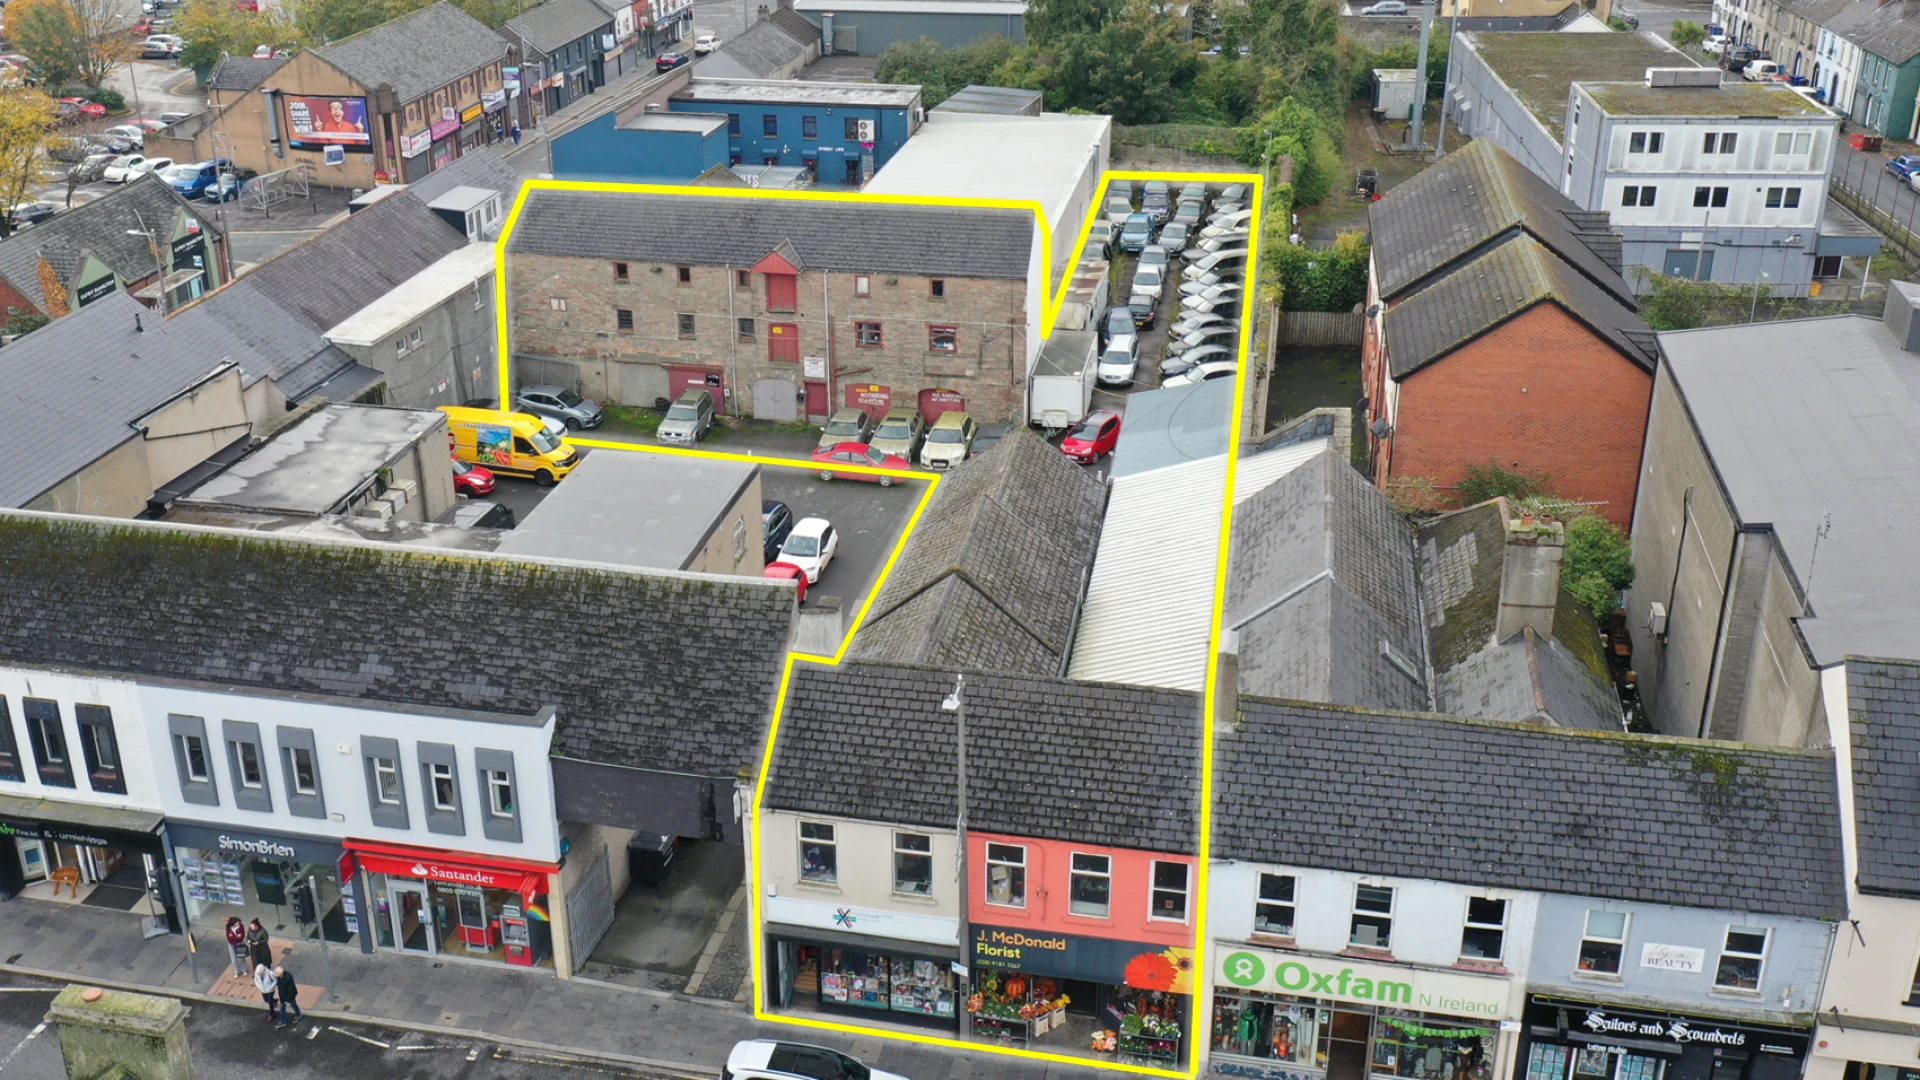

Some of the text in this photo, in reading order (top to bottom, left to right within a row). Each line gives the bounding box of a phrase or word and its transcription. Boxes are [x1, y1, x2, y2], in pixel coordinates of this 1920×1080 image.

[218, 835, 295, 858] SimonBrien
[431, 866, 495, 884] Santander
[977, 930, 1066, 950] J. McDonald
[976, 943, 1021, 959] Florist
[1647, 957, 1695, 970] BEAUTY
[1275, 962, 1412, 1003] Oxfam
[1419, 993, 1499, 1015] N Ireland
[1583, 1010, 1746, 1045] Sailors and Scoundrels
